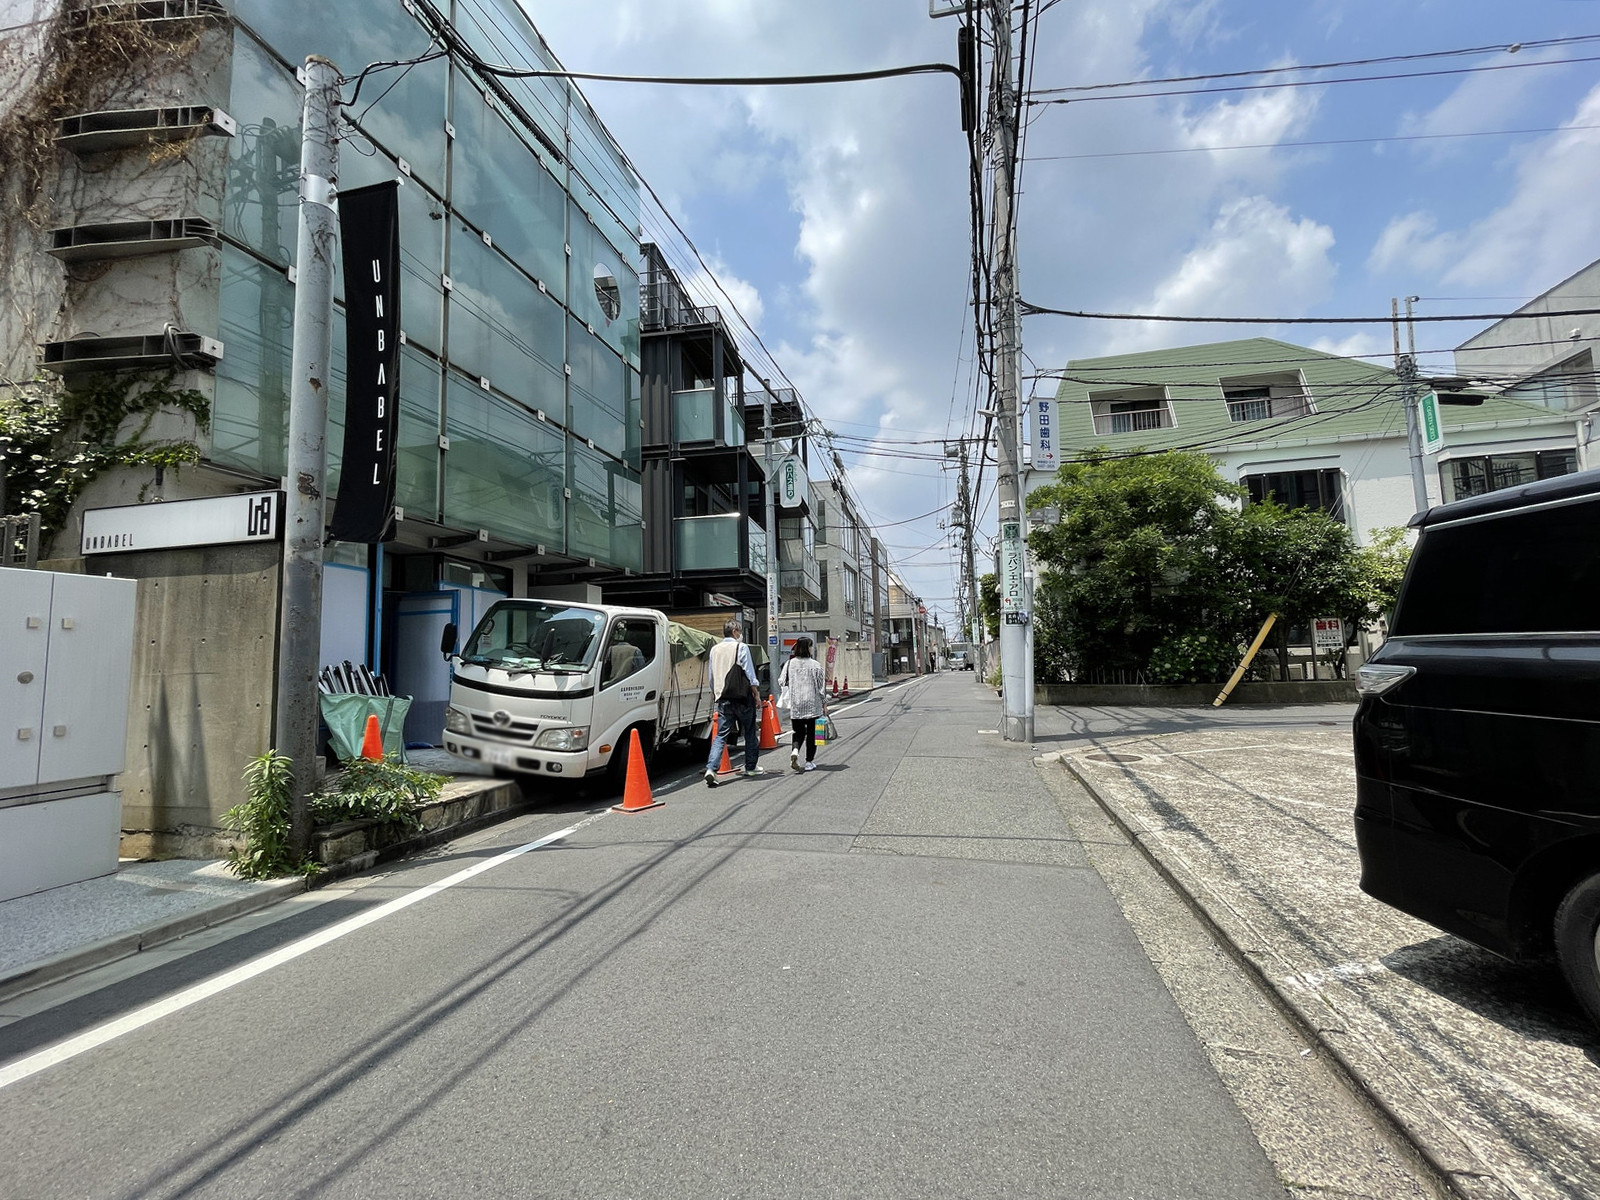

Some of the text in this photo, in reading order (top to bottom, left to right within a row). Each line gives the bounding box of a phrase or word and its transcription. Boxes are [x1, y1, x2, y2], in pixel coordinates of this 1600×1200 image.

[372, 259, 386, 484] UNBABEL
[1038, 401, 1050, 451] 野田歯科
[786, 466, 794, 497] ロハス通り
[85, 533, 134, 550] UNBABEL
[1316, 620, 1339, 630] 歯科
